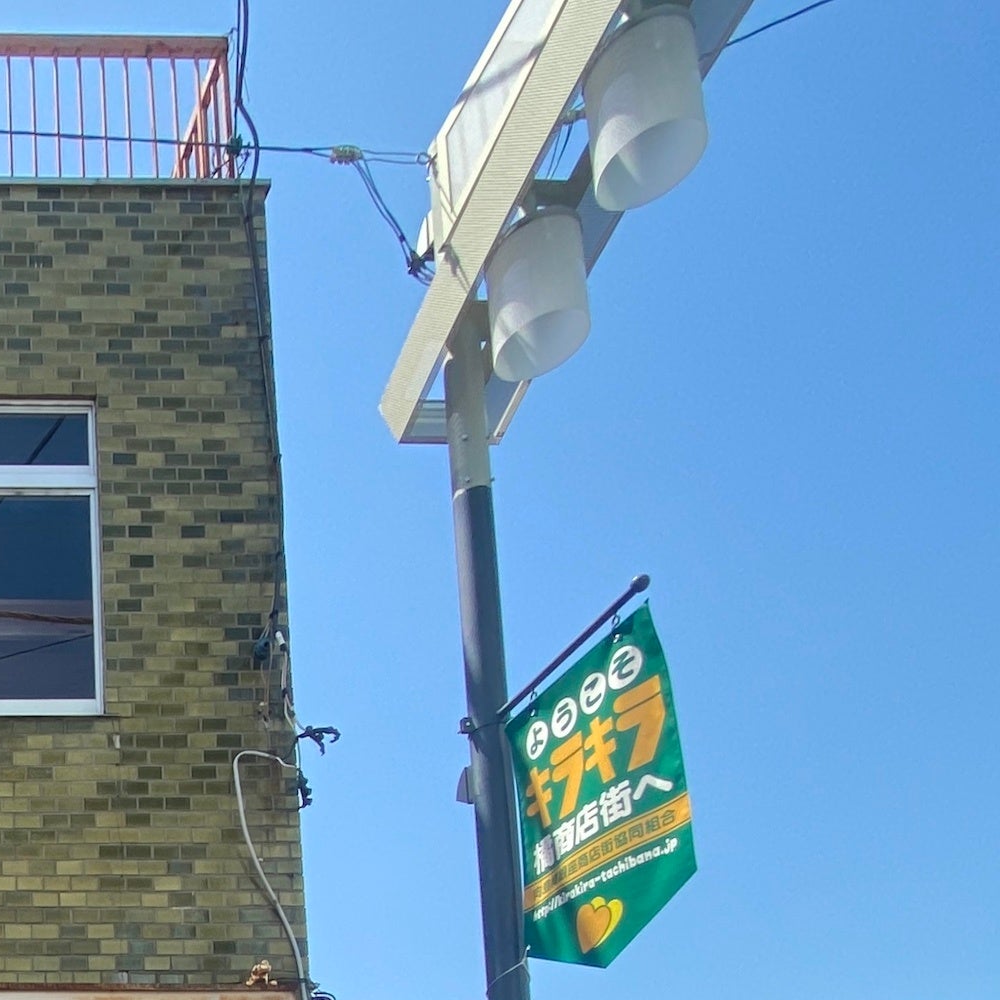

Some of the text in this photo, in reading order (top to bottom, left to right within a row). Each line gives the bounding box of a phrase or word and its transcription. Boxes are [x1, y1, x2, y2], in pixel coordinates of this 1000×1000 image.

[525, 674, 666, 829] キラキラ
[528, 648, 637, 757] ようこそ
[533, 774, 674, 875] 橘商店街へ
